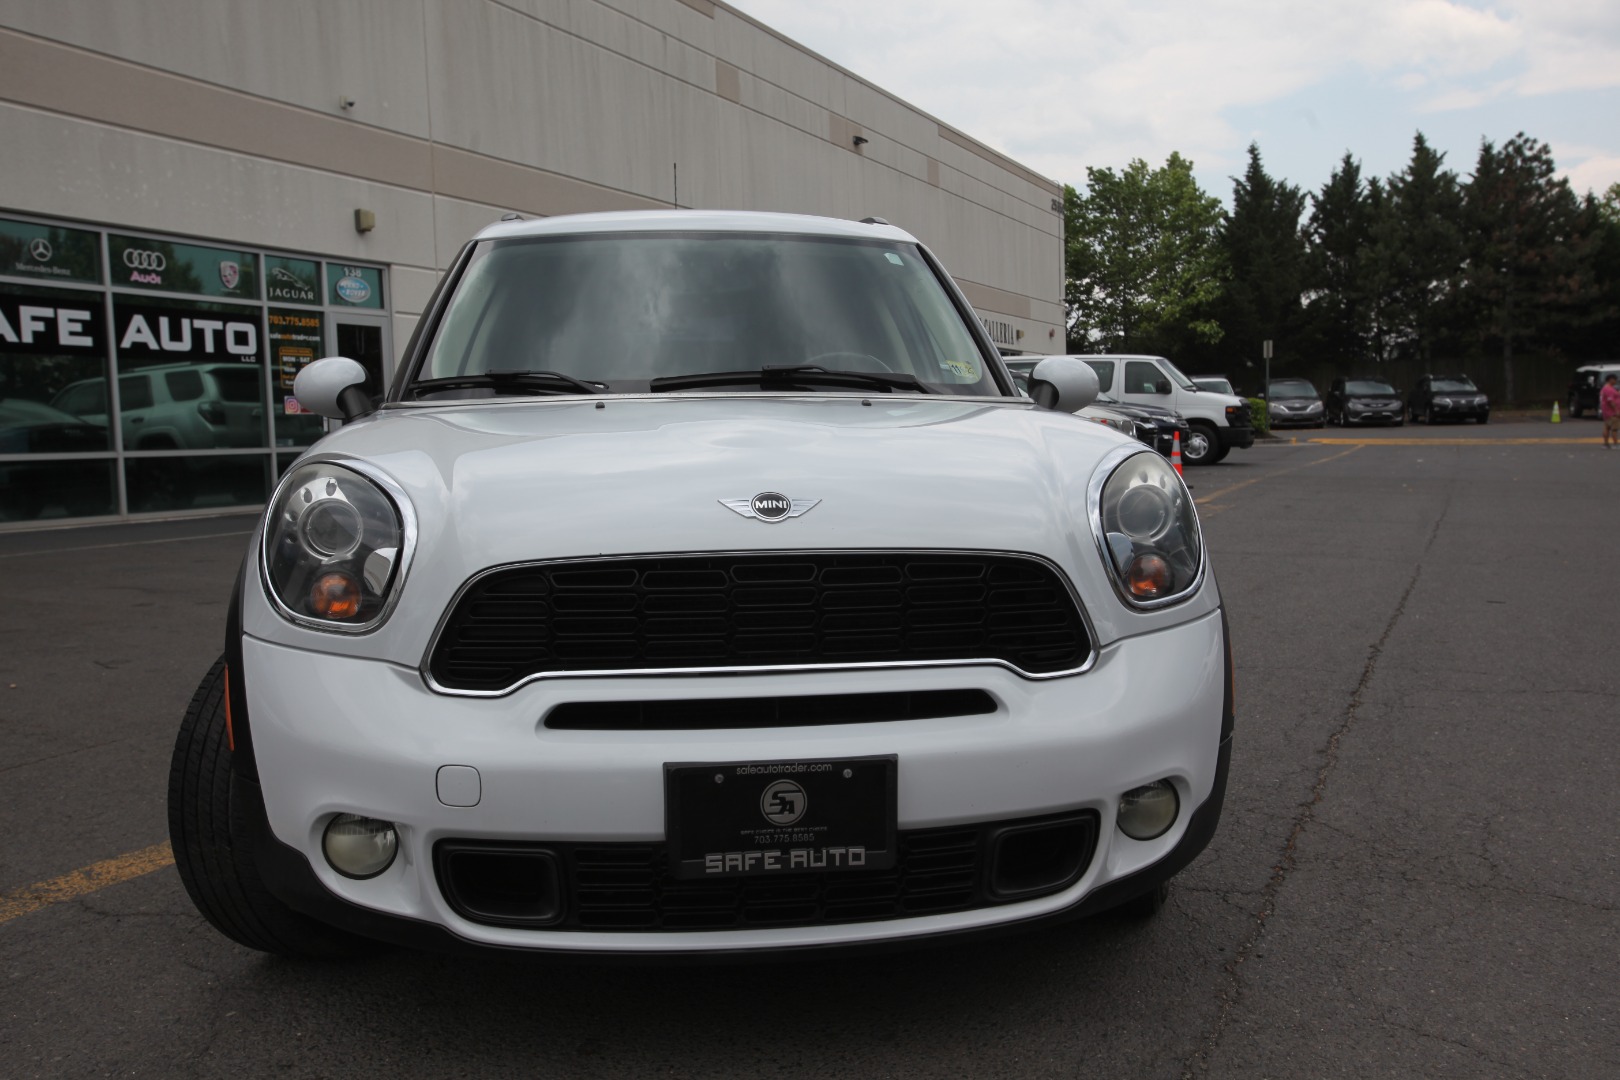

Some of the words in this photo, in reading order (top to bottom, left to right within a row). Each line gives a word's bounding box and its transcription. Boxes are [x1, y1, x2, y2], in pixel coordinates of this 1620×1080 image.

[130, 271, 162, 284] Audi
[269, 287, 314, 300] JAGUAR
[119, 314, 257, 355] AUTO
[755, 500, 788, 509] MINI
[736, 763, 833, 776] safeautotrader.com
[754, 833, 815, 844] 703.775.8585
[705, 851, 782, 873] SAFE
[790, 847, 866, 869] AUTO
